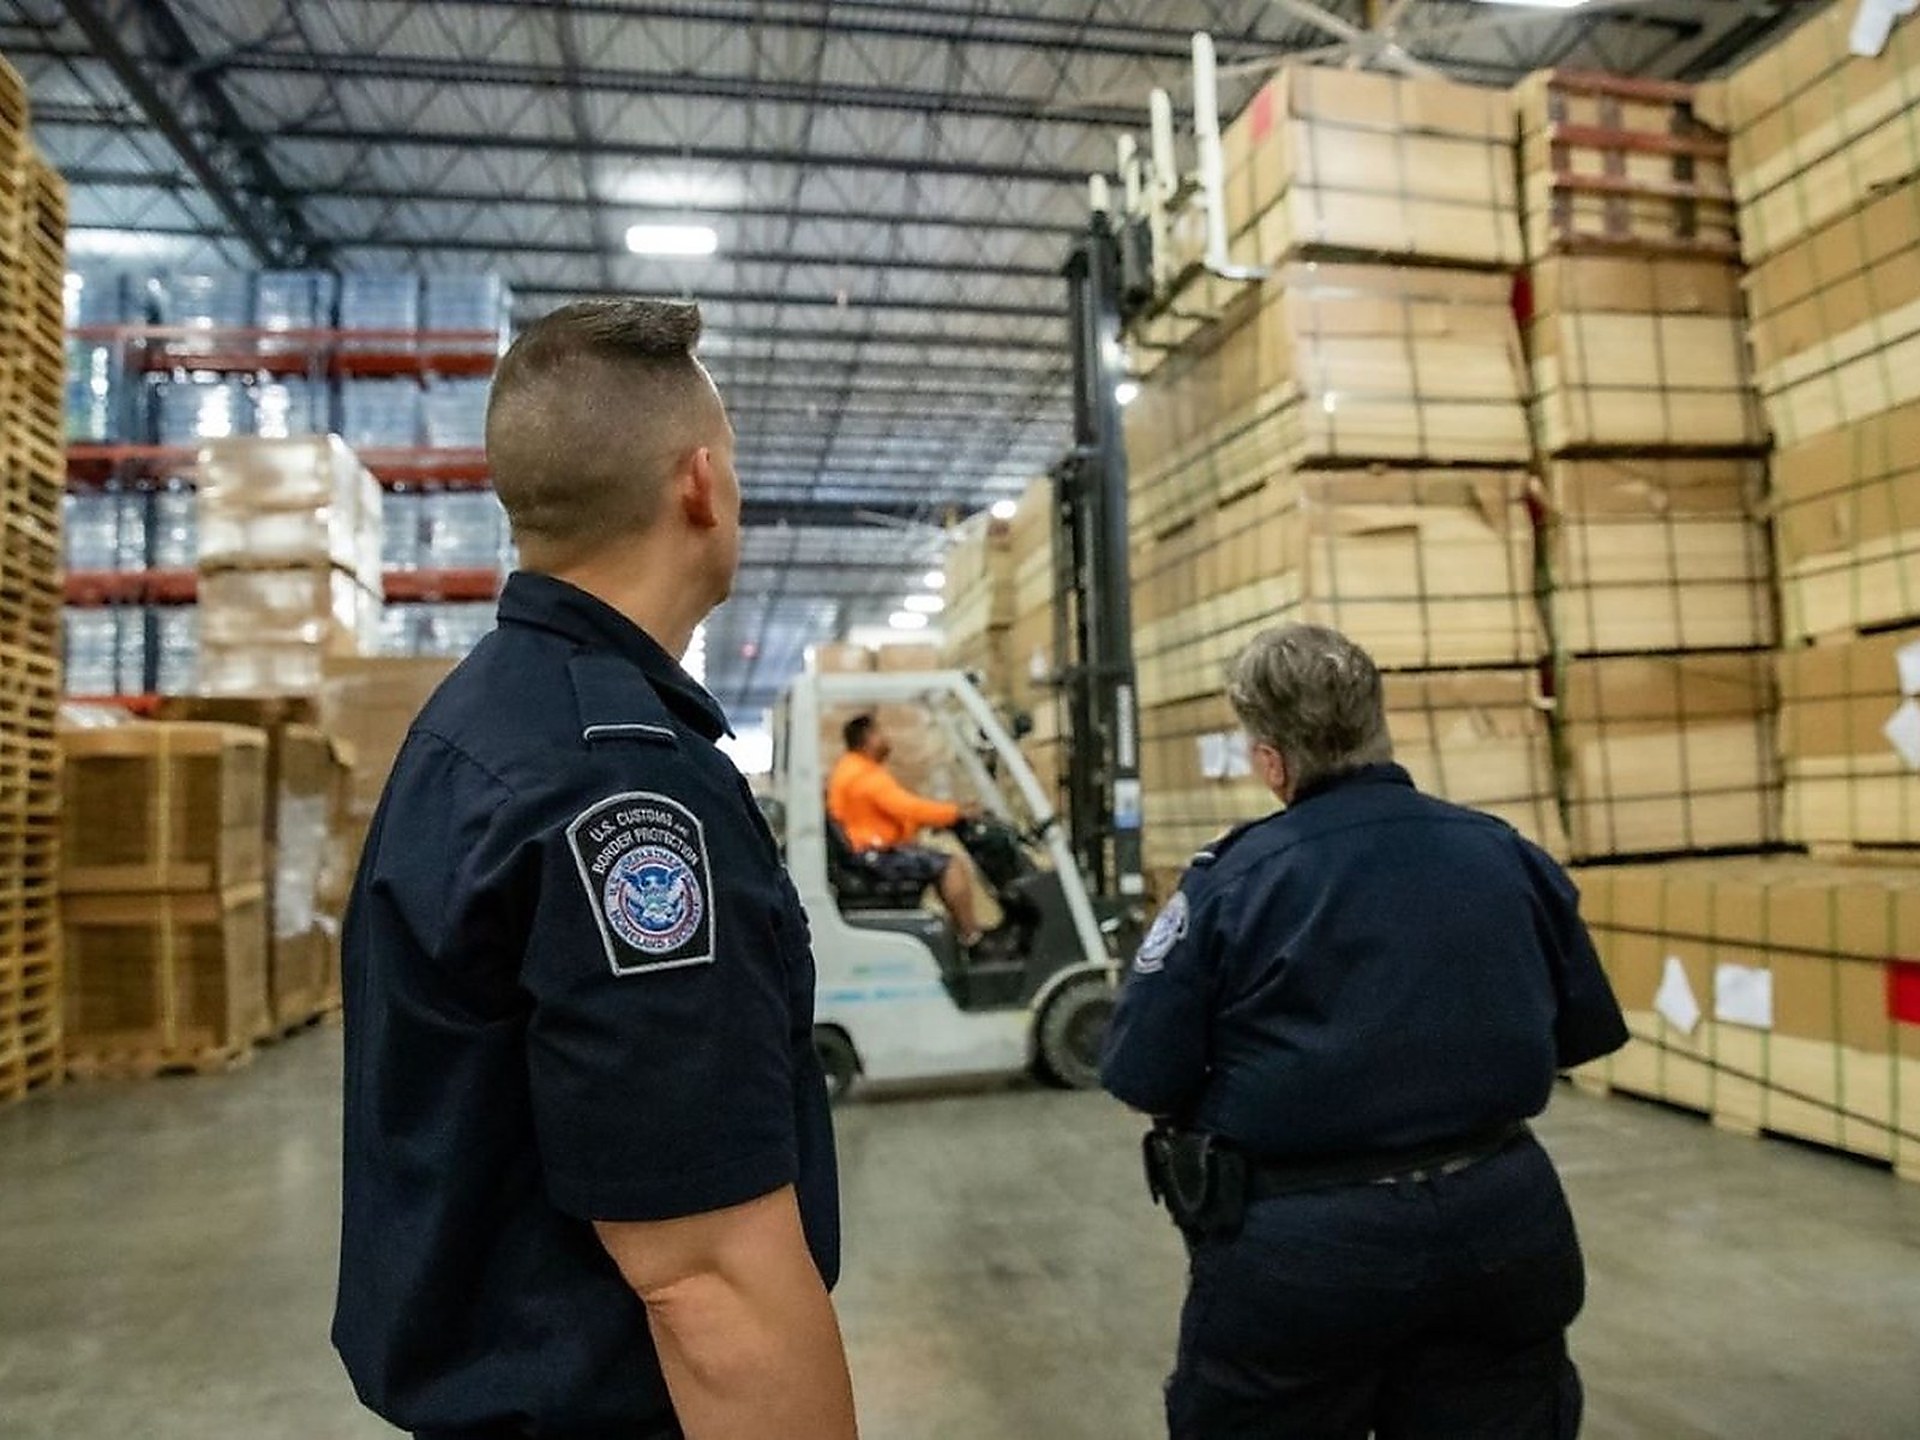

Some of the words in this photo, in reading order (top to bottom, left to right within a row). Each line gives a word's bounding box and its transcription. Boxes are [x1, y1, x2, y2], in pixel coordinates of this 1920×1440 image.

[616, 808, 673, 826] CUSTOMS
[592, 831, 634, 873] BORDER
[633, 827, 699, 865] PROTECTION
